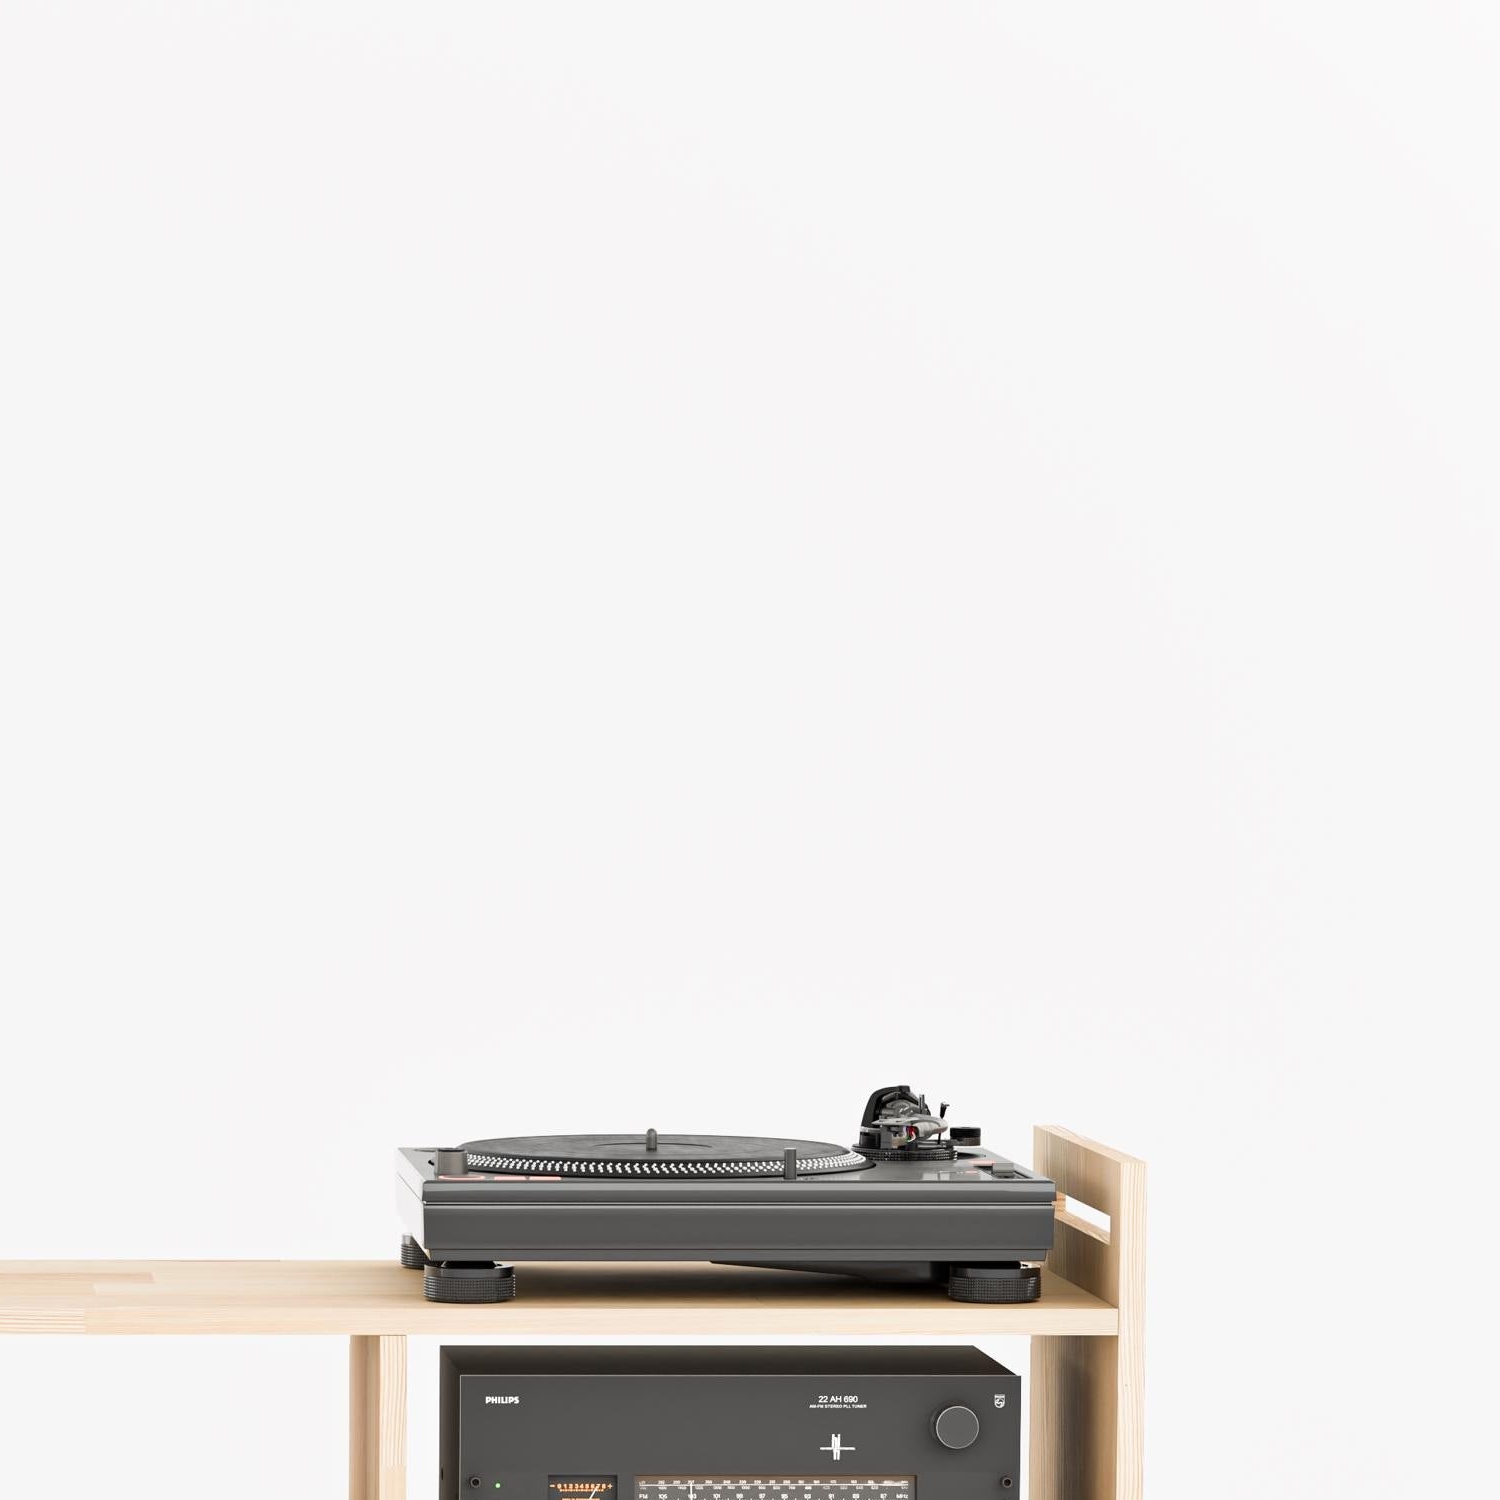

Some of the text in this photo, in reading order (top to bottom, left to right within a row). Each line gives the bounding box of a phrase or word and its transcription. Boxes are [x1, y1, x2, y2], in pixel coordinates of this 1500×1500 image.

[485, 1396, 520, 1404] PHILIPS
[818, 1395, 858, 1403] 22 AH 690
